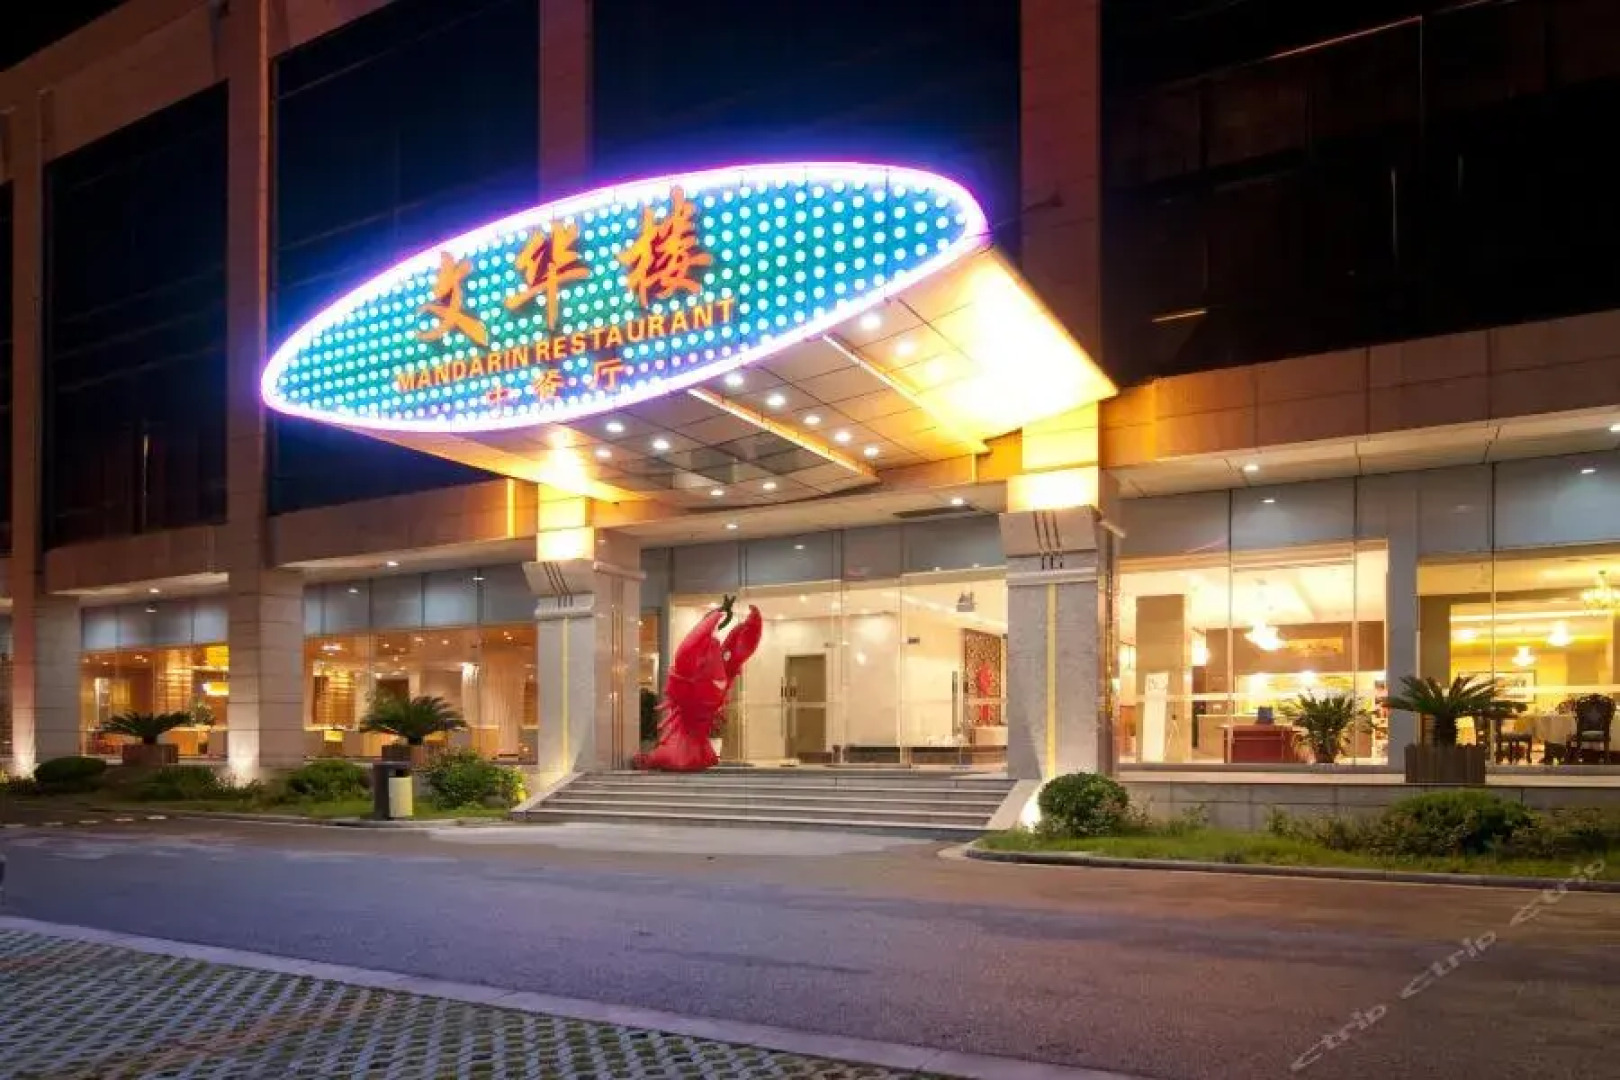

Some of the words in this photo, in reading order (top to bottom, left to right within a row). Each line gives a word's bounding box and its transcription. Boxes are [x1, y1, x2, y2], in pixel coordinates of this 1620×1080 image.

[416, 185, 712, 346] 文华楼
[397, 345, 529, 393] MANDARIN
[535, 298, 734, 364] RESTAURANT
